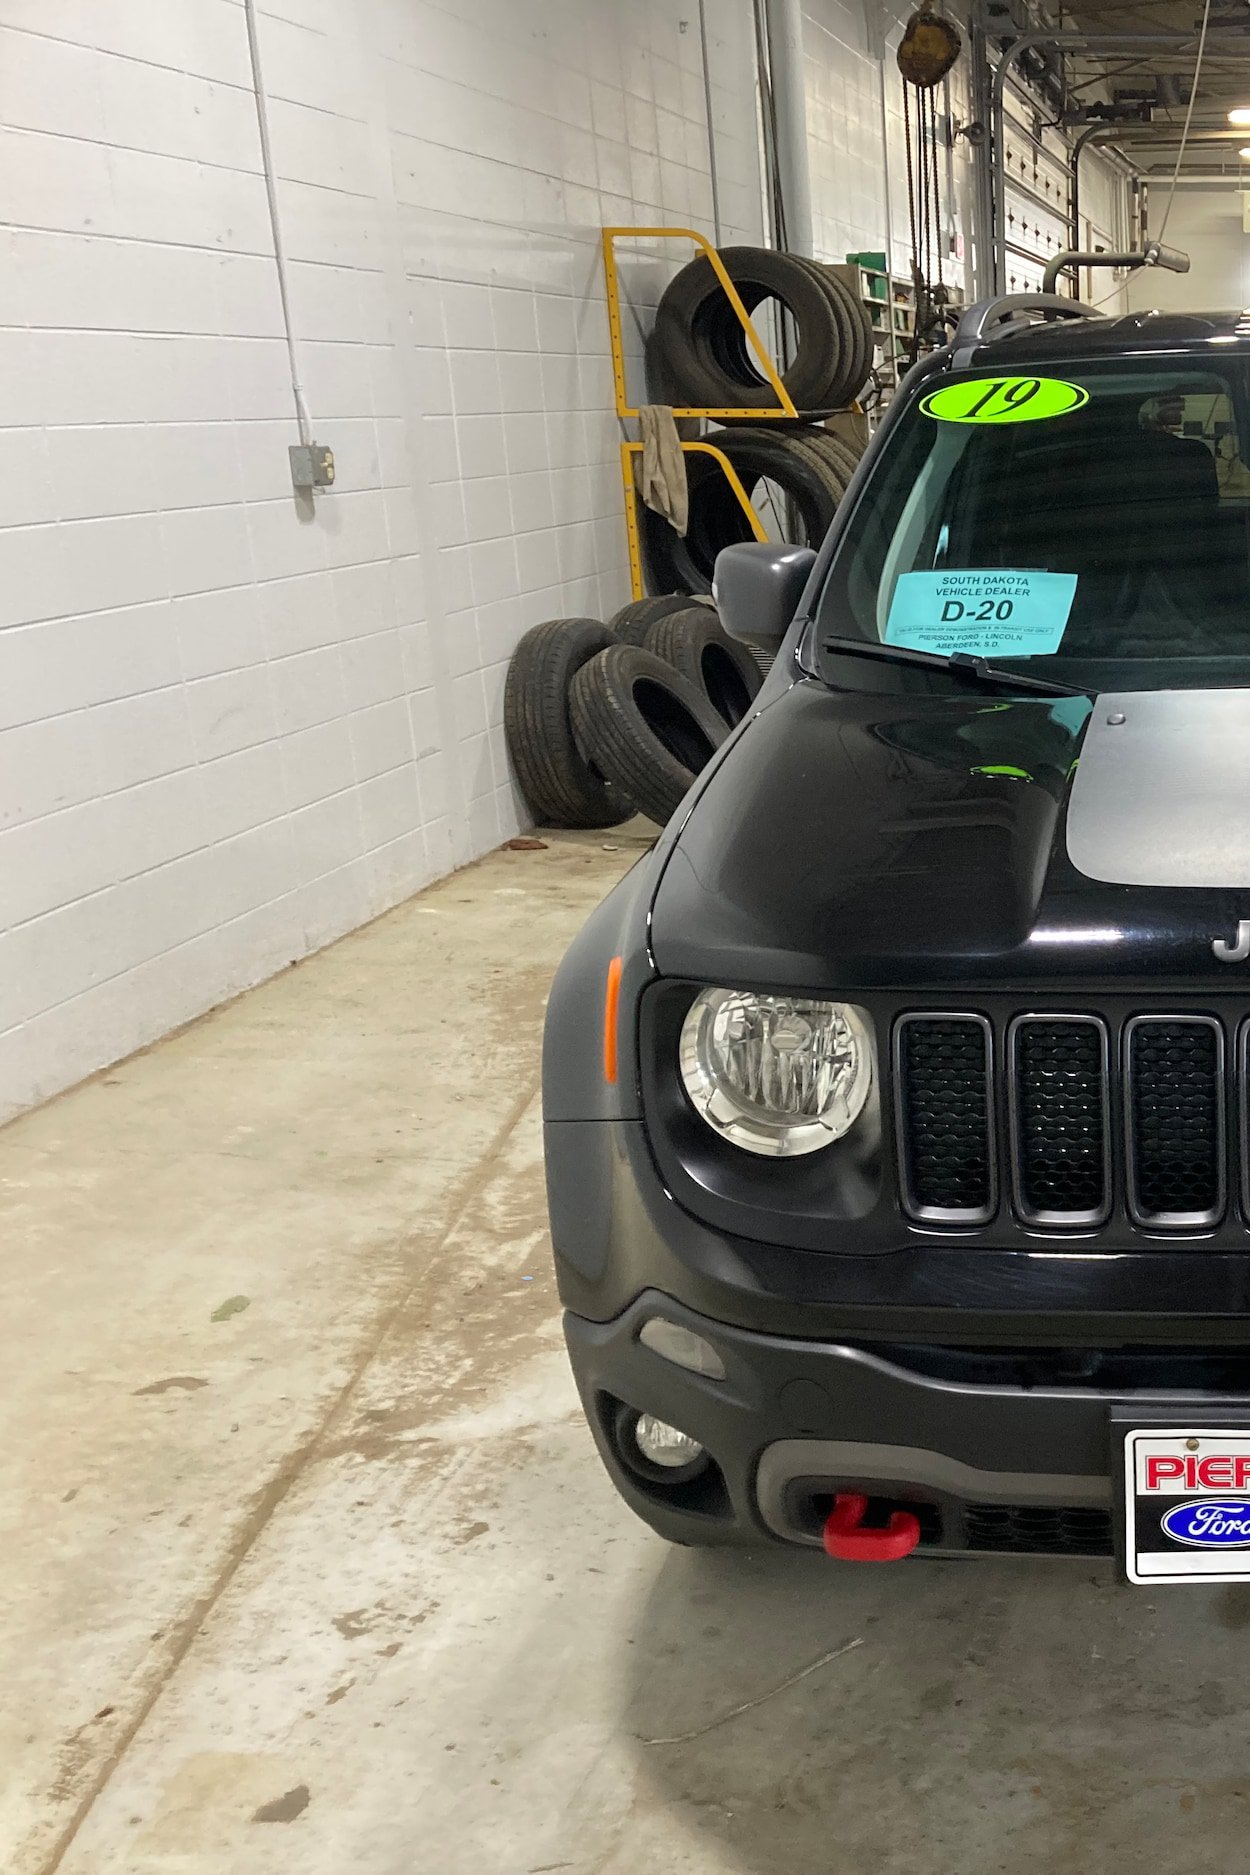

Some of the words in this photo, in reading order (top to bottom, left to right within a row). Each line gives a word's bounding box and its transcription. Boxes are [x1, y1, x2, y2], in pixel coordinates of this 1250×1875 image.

[956, 379, 1041, 419] 19
[942, 576, 980, 585] SOUTH
[982, 576, 1029, 586] DAKOTA
[936, 588, 982, 596] VEHICLE
[984, 587, 1031, 597] DEALER
[940, 600, 1014, 622] D-20
[985, 633, 1023, 641] LINCOLN
